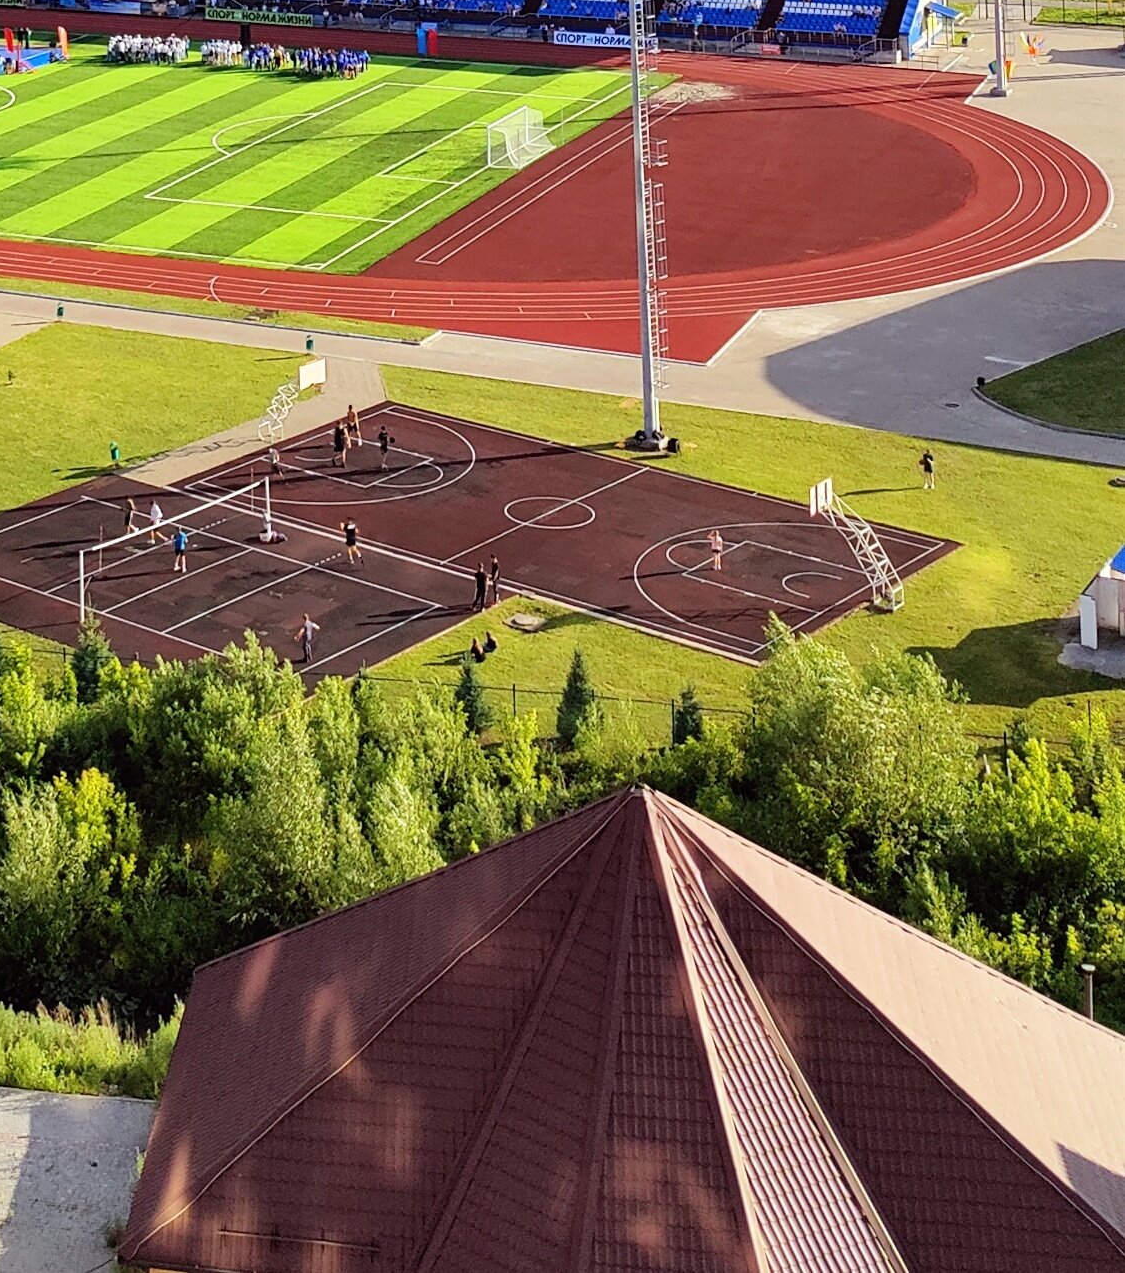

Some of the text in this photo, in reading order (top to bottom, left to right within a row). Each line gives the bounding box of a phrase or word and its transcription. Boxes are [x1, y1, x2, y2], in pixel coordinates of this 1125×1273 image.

[208, 9, 312, 25] СПОРТ НОРМА ЖИЗНИ
[556, 33, 586, 44] СПОРТ
